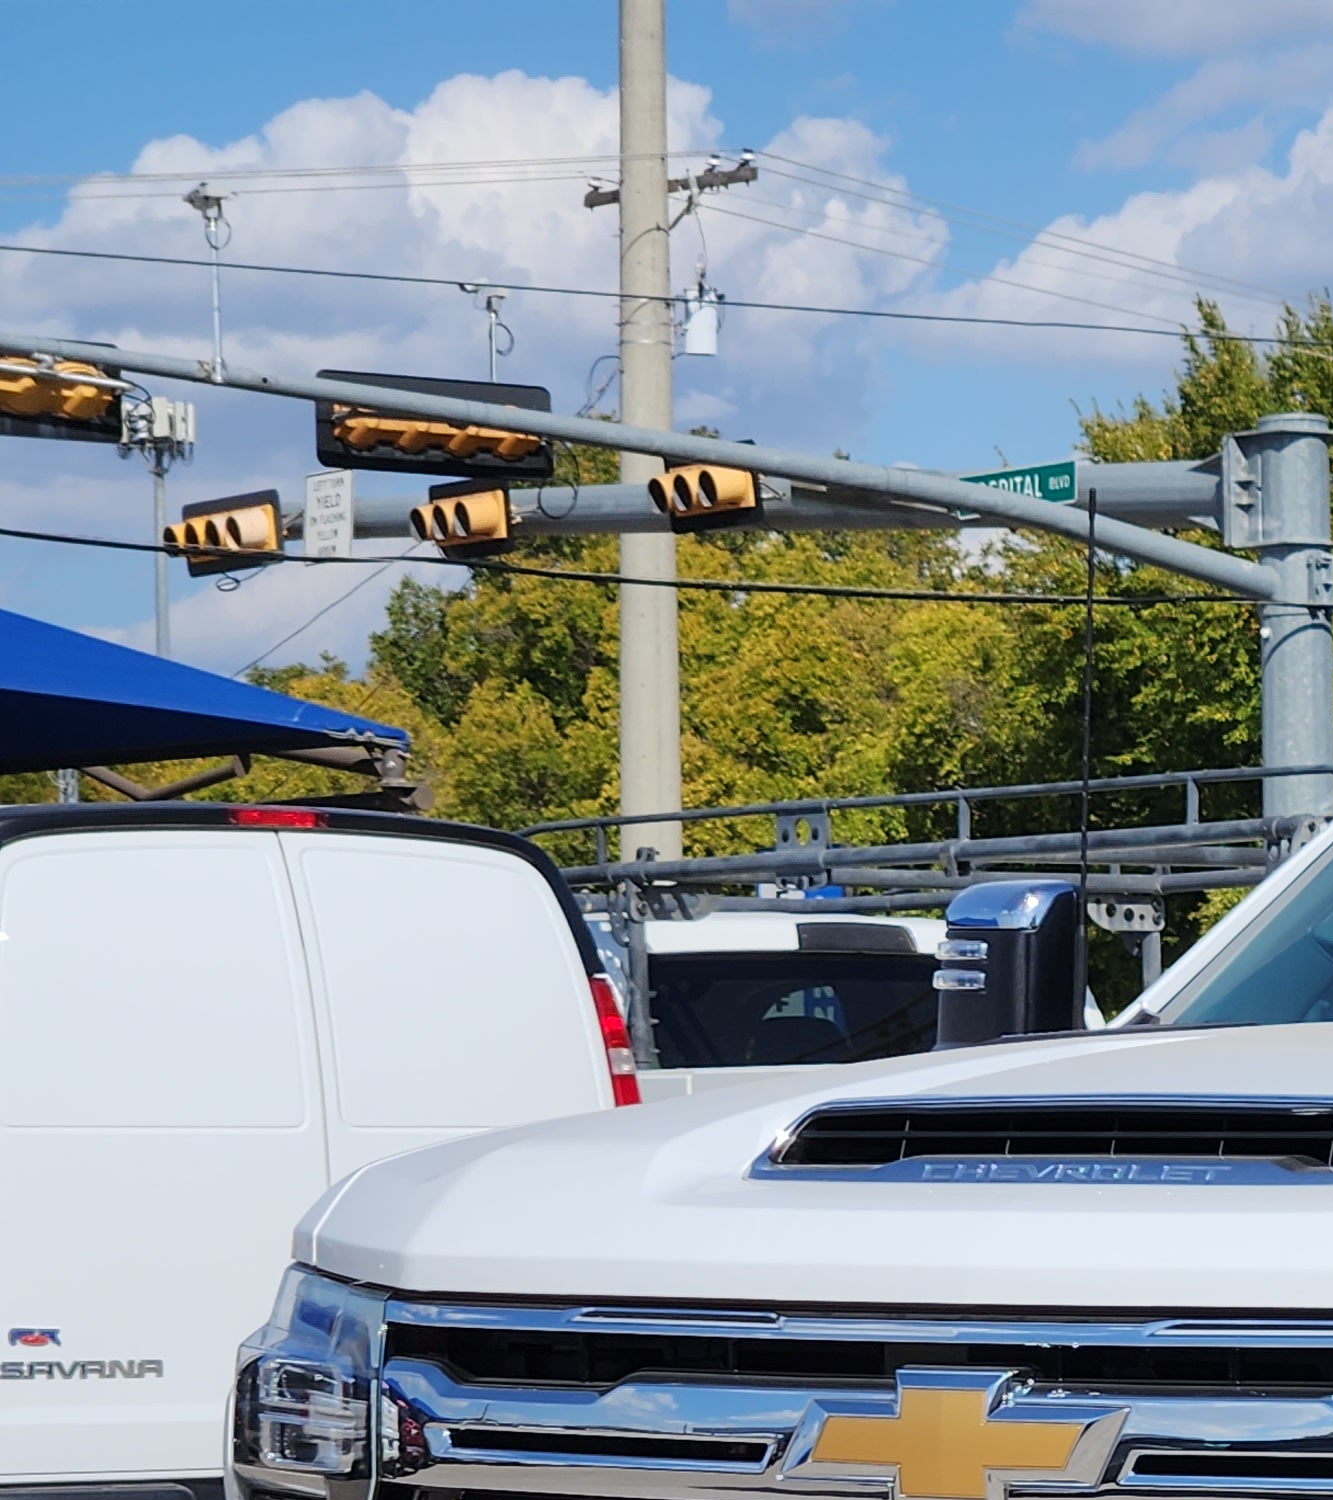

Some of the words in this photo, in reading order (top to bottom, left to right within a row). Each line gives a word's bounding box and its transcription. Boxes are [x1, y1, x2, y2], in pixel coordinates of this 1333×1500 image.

[1048, 474, 1071, 490] BLVD
[316, 493, 341, 509] YIELD
[922, 1163, 1232, 1182] CHEVROLET
[0, 1359, 164, 1380] SAVANA
